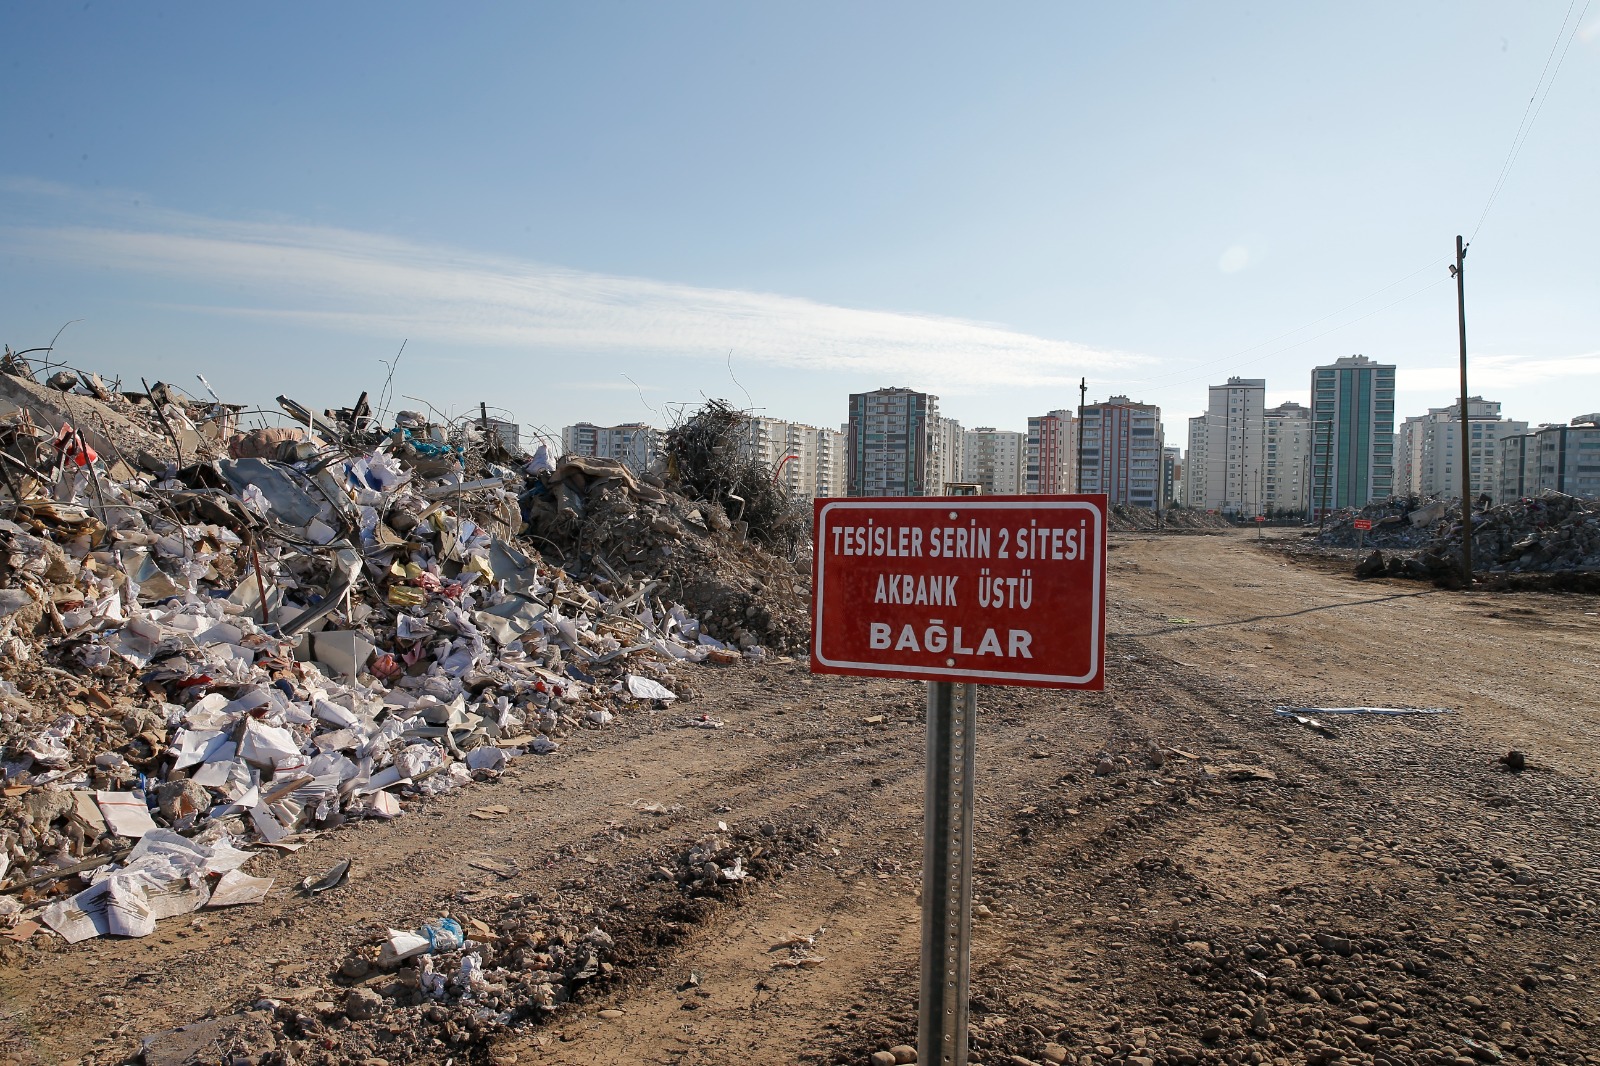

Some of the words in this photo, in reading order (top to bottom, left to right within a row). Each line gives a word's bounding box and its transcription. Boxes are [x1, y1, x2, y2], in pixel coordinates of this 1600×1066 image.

[832, 518, 923, 557] TESİSLER
[929, 518, 992, 559] SERİN
[998, 527, 1010, 560] 2
[1015, 518, 1087, 561] SİTESİ
[874, 573, 959, 607] AKBANK
[978, 568, 1034, 610] ÜSTÜ
